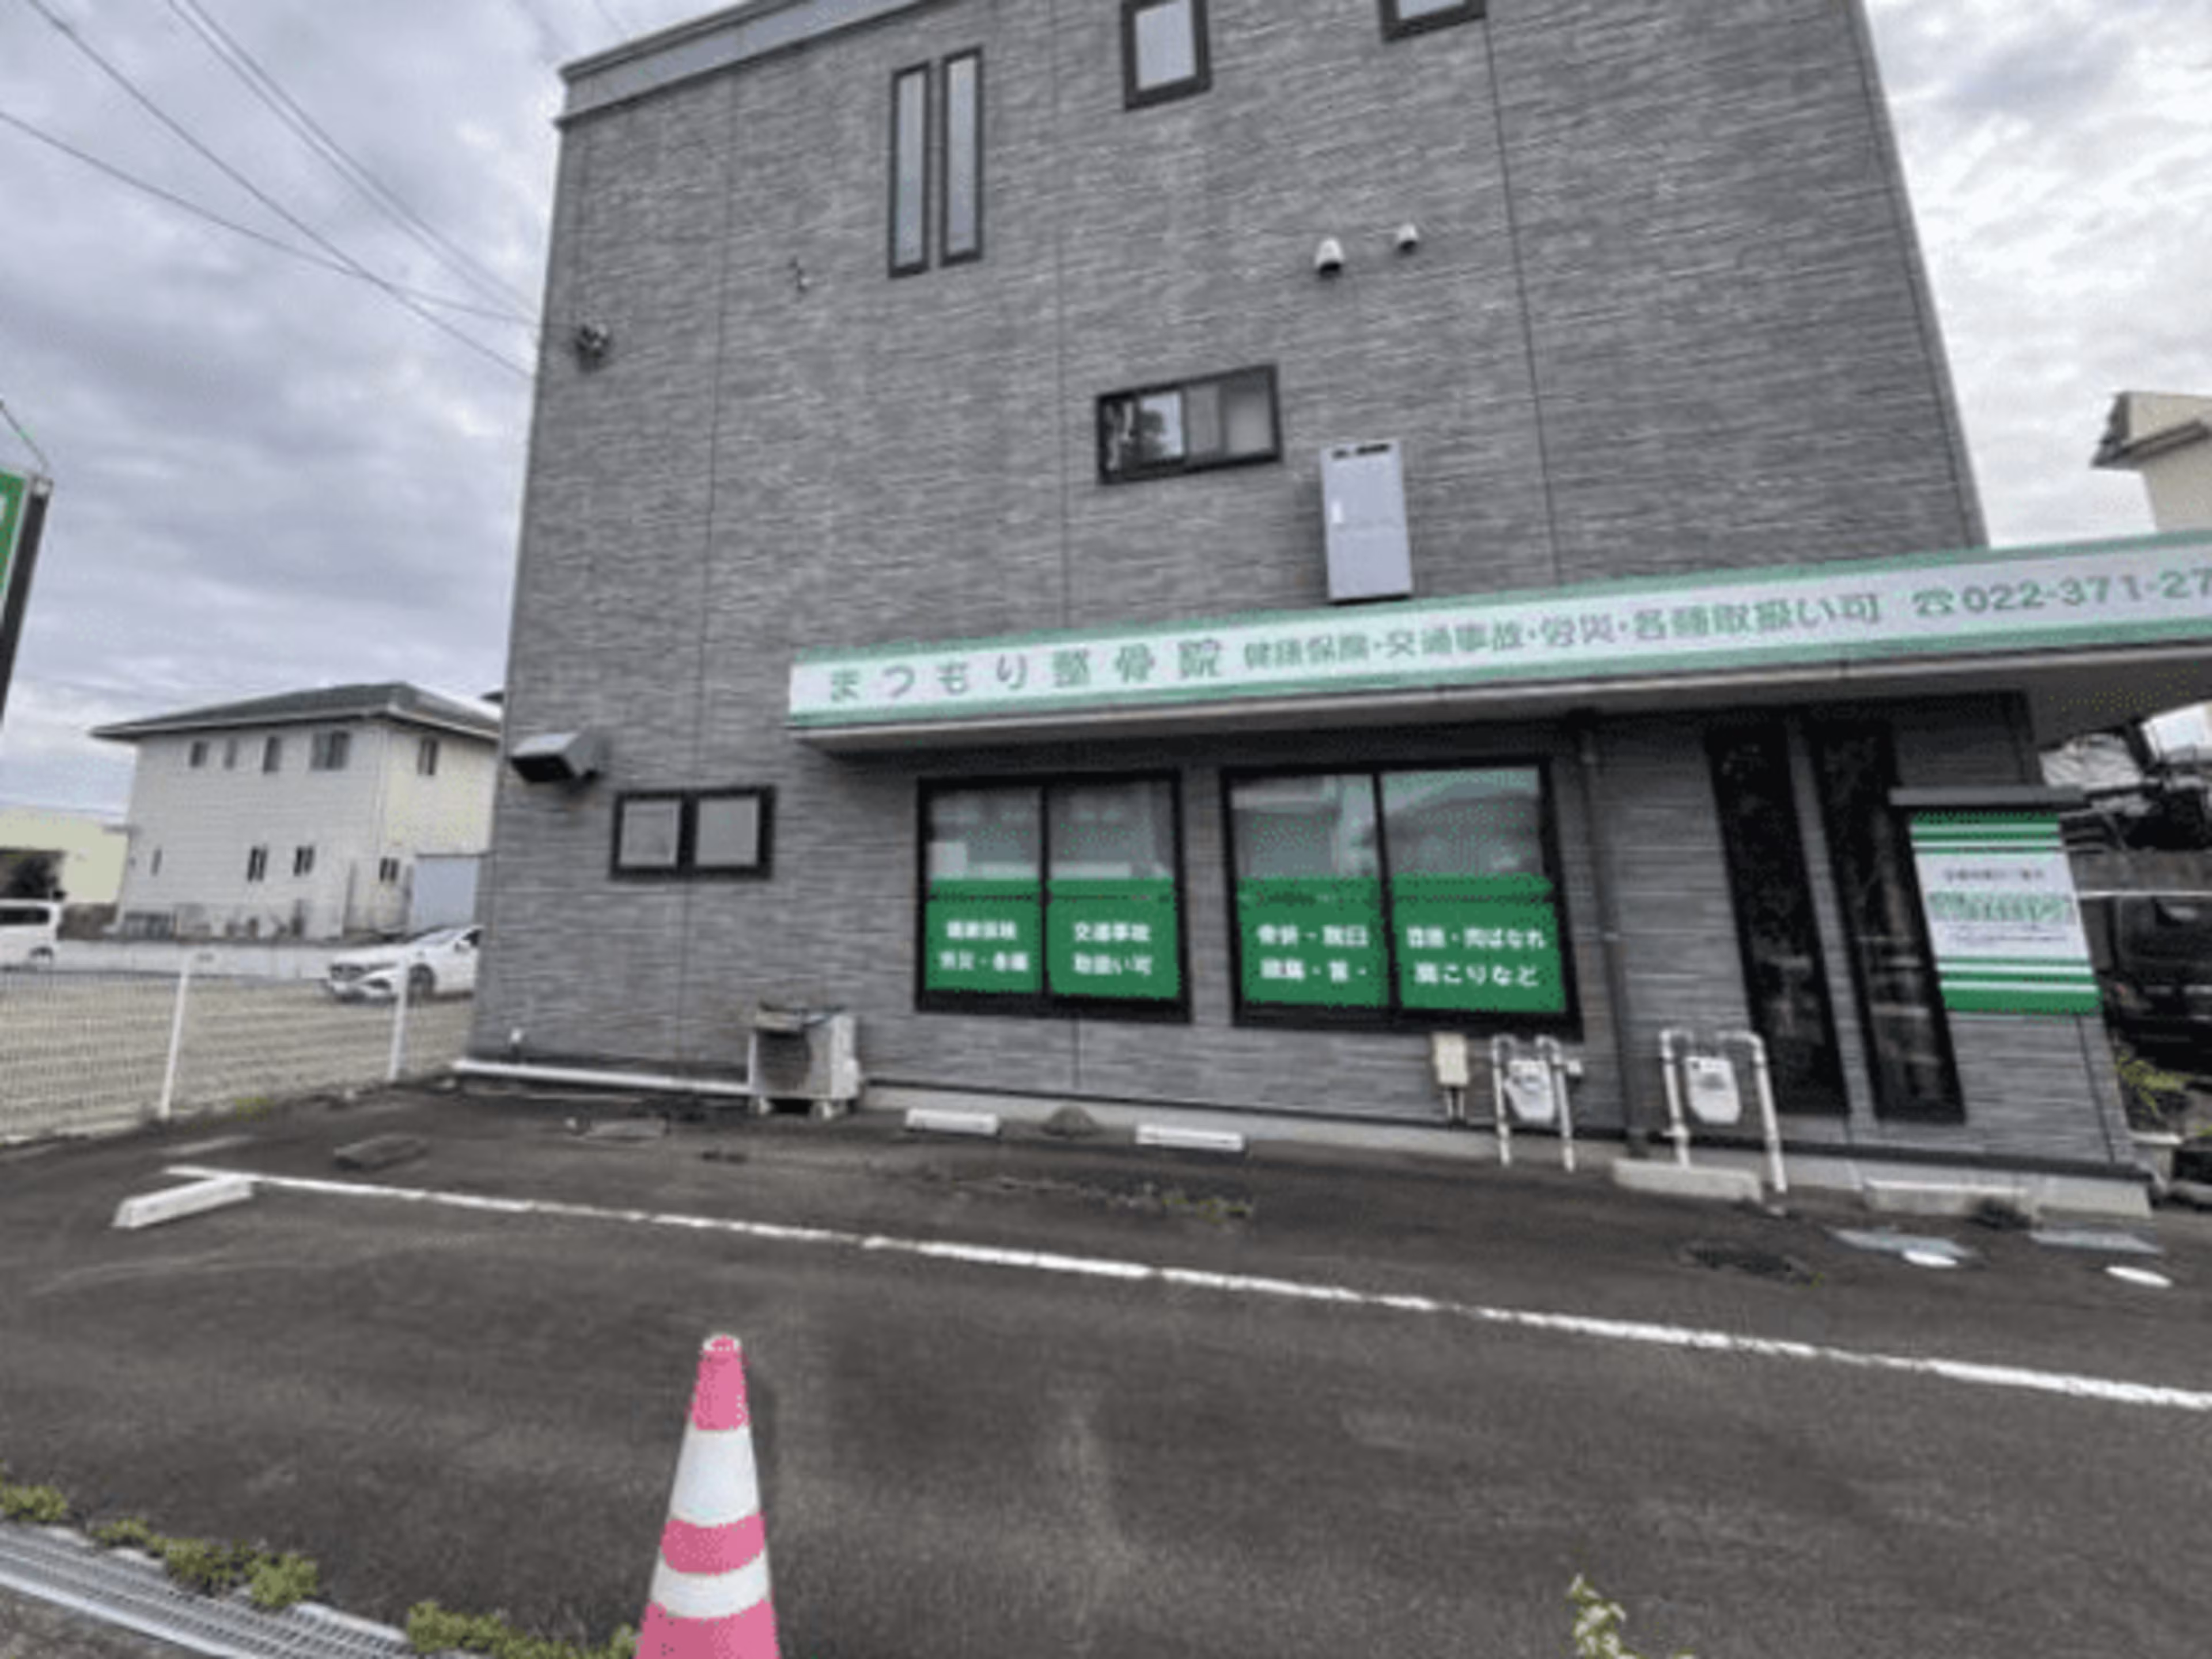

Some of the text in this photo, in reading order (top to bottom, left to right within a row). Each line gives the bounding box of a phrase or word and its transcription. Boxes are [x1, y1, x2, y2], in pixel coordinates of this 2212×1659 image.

[830, 638, 1220, 702] まつもり整骨院
